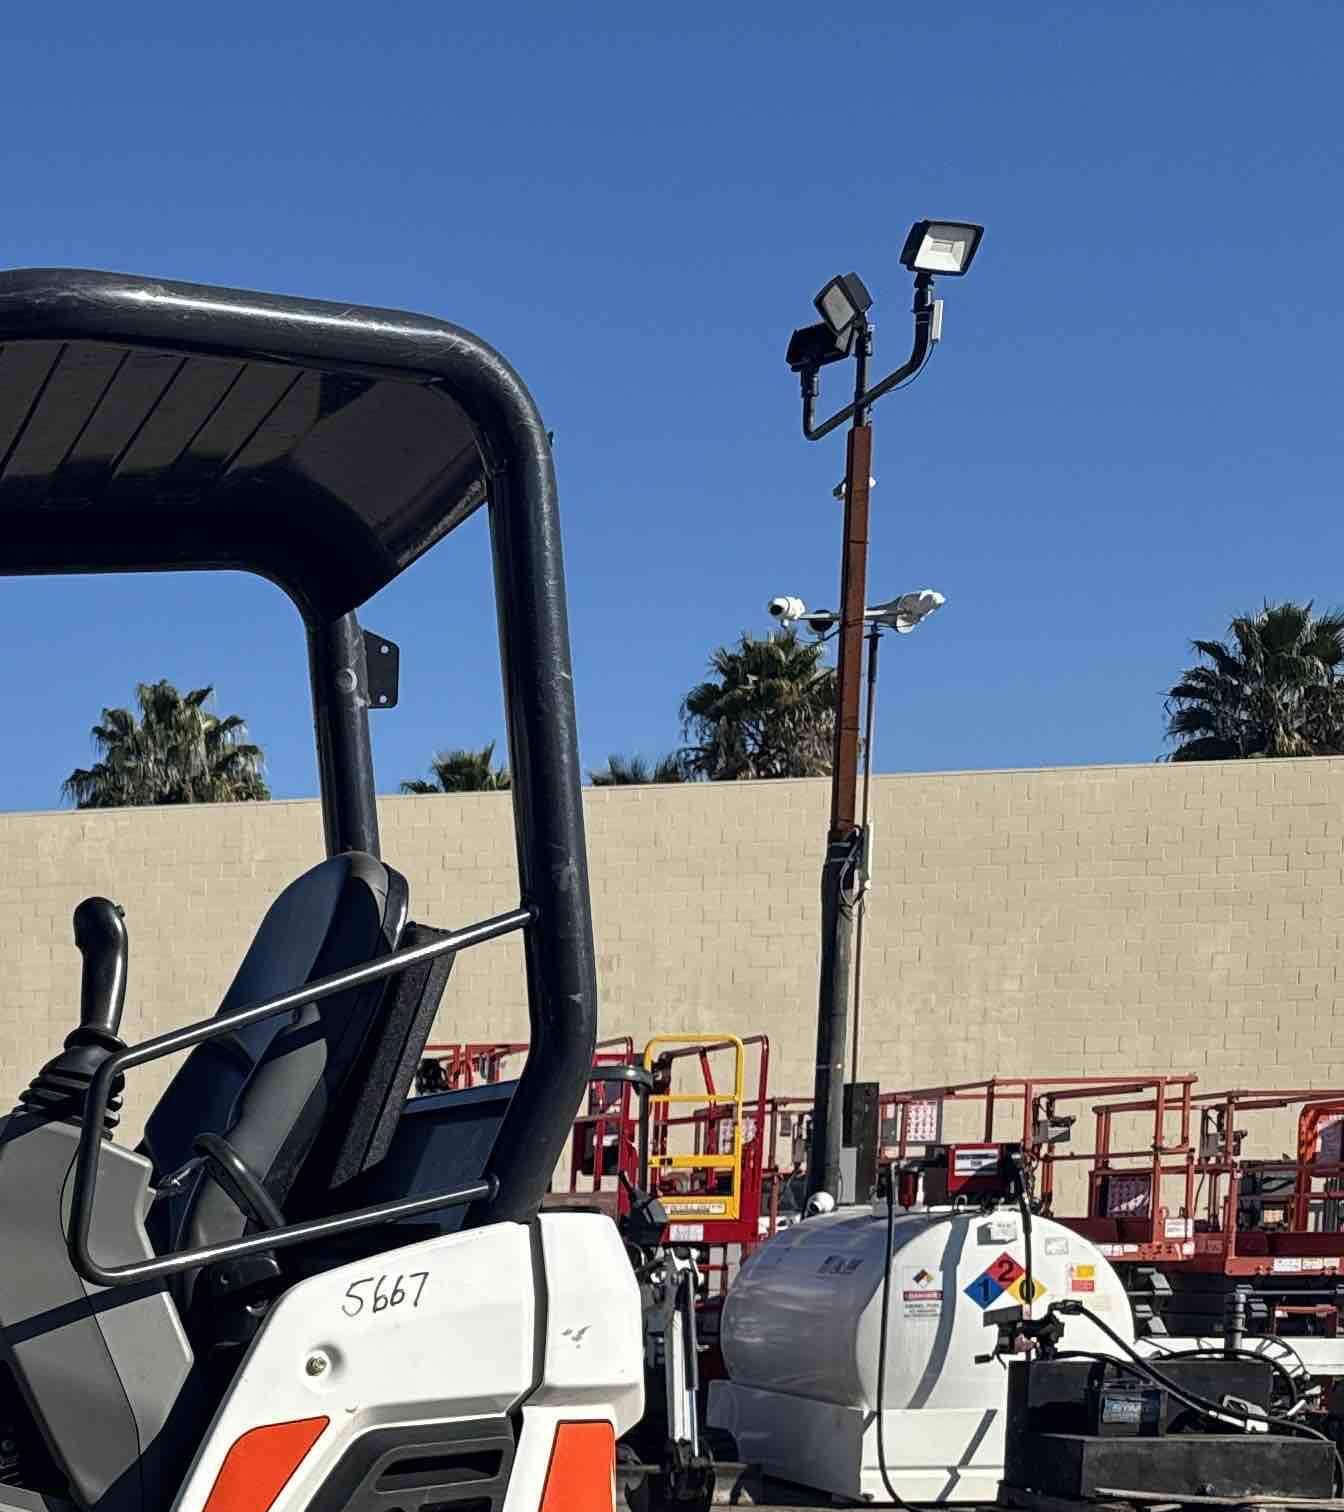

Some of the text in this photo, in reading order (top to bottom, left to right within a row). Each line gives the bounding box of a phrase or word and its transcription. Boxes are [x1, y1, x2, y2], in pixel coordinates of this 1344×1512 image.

[998, 1260, 1013, 1282] 2
[341, 1271, 430, 1317] 5667
[979, 1277, 991, 1299] 1
